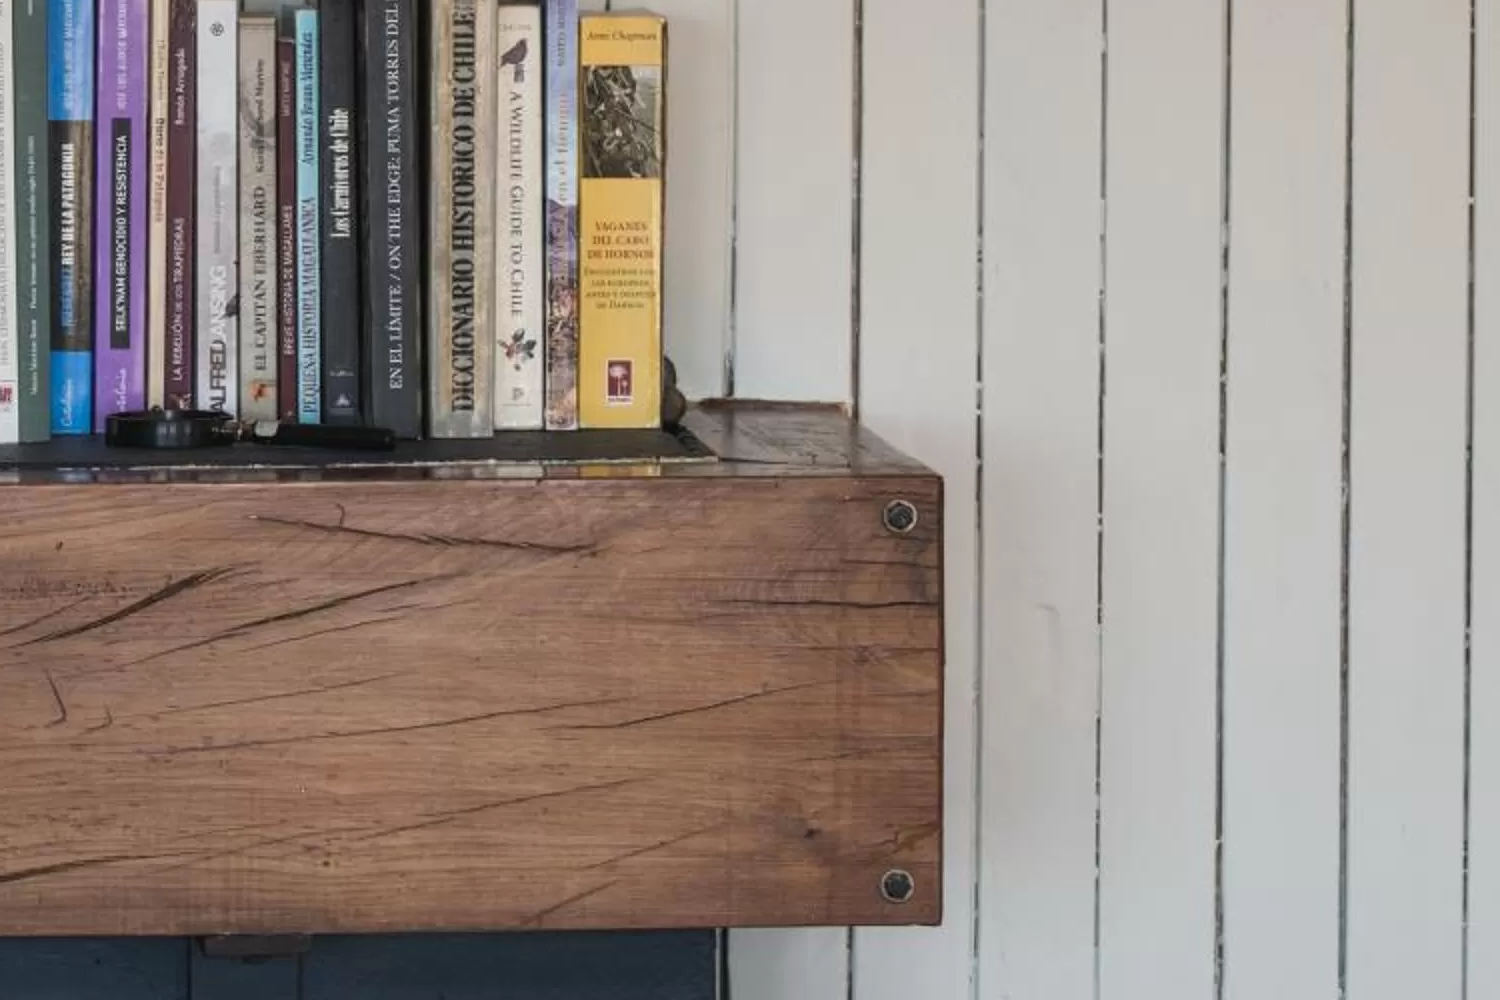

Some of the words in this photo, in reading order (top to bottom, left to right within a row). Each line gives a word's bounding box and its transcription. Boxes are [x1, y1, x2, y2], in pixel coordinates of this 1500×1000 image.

[386, 3, 399, 36] DEL
[451, 10, 475, 84] CHILE
[387, 39, 400, 104] TORRES
[451, 87, 475, 120] DE
[509, 91, 523, 105] A
[328, 107, 349, 137] Chile
[387, 106, 401, 153] PUMA
[328, 139, 350, 153] de
[509, 106, 524, 183] WILDLIFE
[60, 143, 75, 209] PATAGONIA
[116, 136, 127, 205] RESISTENCIA
[387, 157, 401, 204] EDGE:
[60, 209, 76, 225] LA
[115, 206, 127, 215] Y
[388, 207, 402, 239] THE
[509, 184, 524, 237] GUIDE
[60, 225, 76, 241] DE
[253, 185, 267, 275] EBERHARD
[329, 217, 351, 238] Los
[60, 244, 76, 265] REY
[115, 218, 127, 275] GENOCIDIO
[389, 240, 402, 270] ON
[509, 268, 525, 317] CHILE
[301, 289, 317, 349] HISTORIA
[384, 284, 403, 341] LÍMITE
[451, 259, 475, 413] DICCIONARIO
[253, 351, 267, 371] EL
[389, 343, 403, 364] EL
[172, 368, 183, 381] LA
[209, 339, 226, 412] ALFRED
[389, 365, 403, 389] EN
